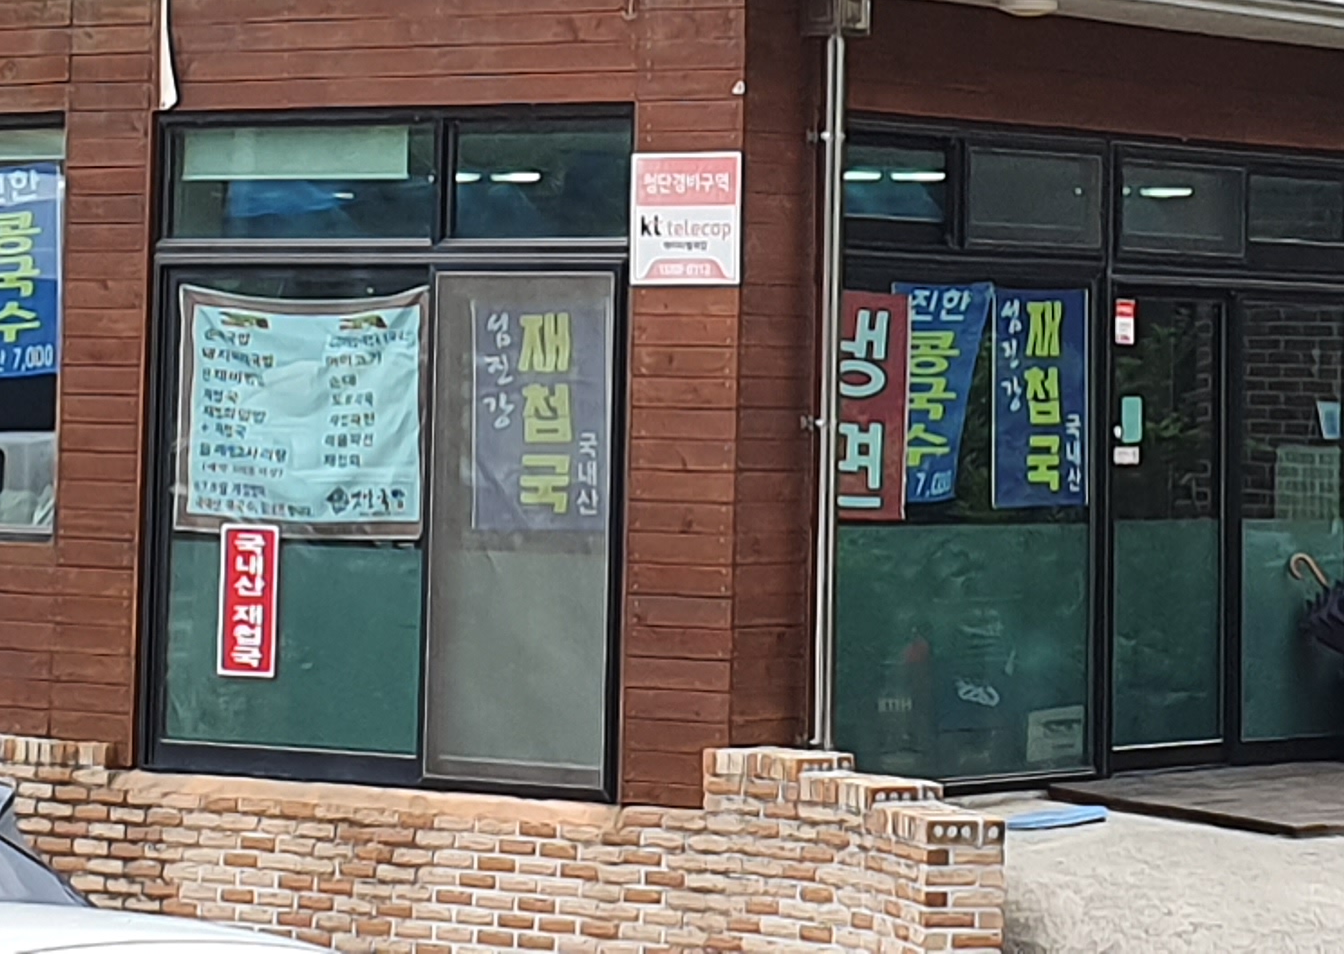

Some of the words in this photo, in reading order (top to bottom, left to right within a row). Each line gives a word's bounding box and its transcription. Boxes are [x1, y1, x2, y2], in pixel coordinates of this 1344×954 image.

[668, 219, 731, 240] telecop
[911, 289, 972, 322] 진한
[12, 344, 54, 372] 7,000
[483, 313, 514, 428] 섬진강
[1001, 298, 1022, 412] 섬진강
[518, 312, 572, 513] 재첩국
[1024, 300, 1062, 492] 재첩국
[577, 432, 598, 516] 국내산
[1065, 413, 1082, 493] 국내산
[233, 532, 266, 596] 국내산
[230, 604, 263, 668] 재첩국
